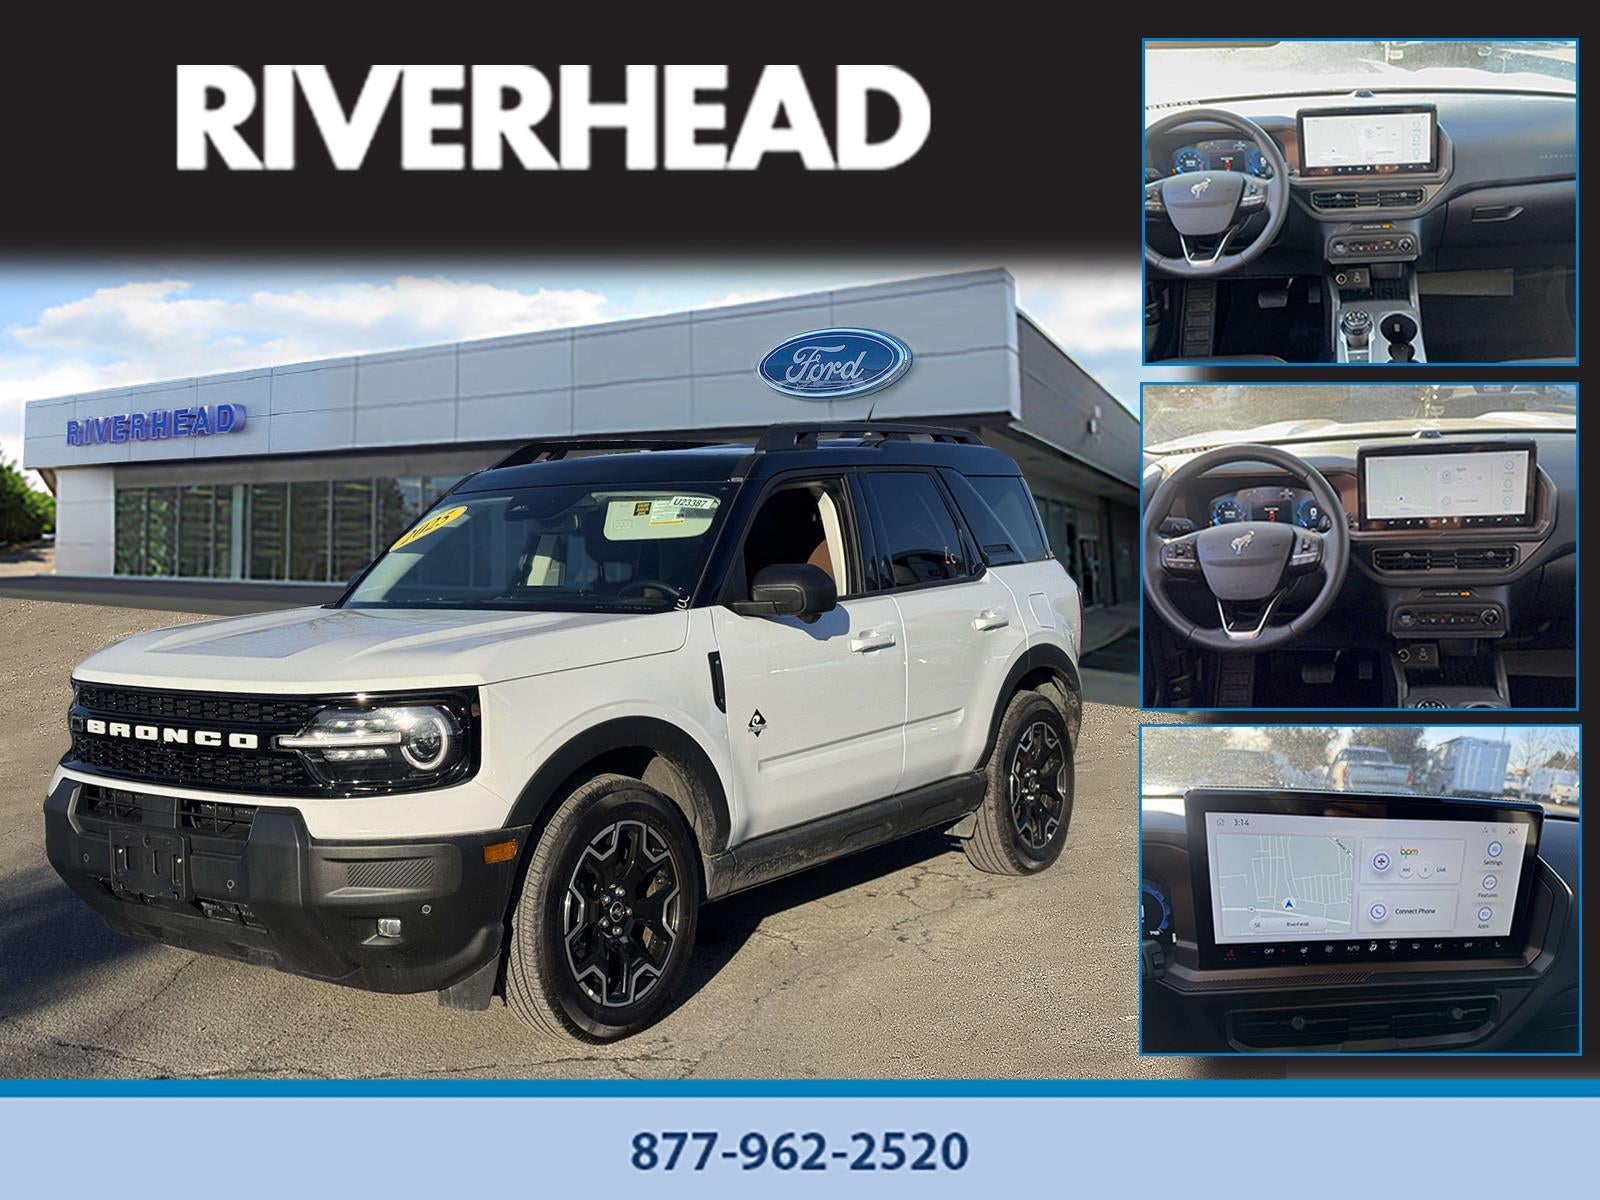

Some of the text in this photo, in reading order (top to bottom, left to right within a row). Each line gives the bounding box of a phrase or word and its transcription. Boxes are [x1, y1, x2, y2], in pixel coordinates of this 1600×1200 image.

[785, 343, 868, 386] Ford
[66, 403, 247, 447] RIVERHEAD
[672, 497, 710, 508] U23387
[85, 719, 259, 750] BRONCO
[1233, 818, 1250, 827] 3:14
[1399, 845, 1419, 858] bpm
[1482, 859, 1503, 867] Settings
[1394, 907, 1417, 915] Connect
